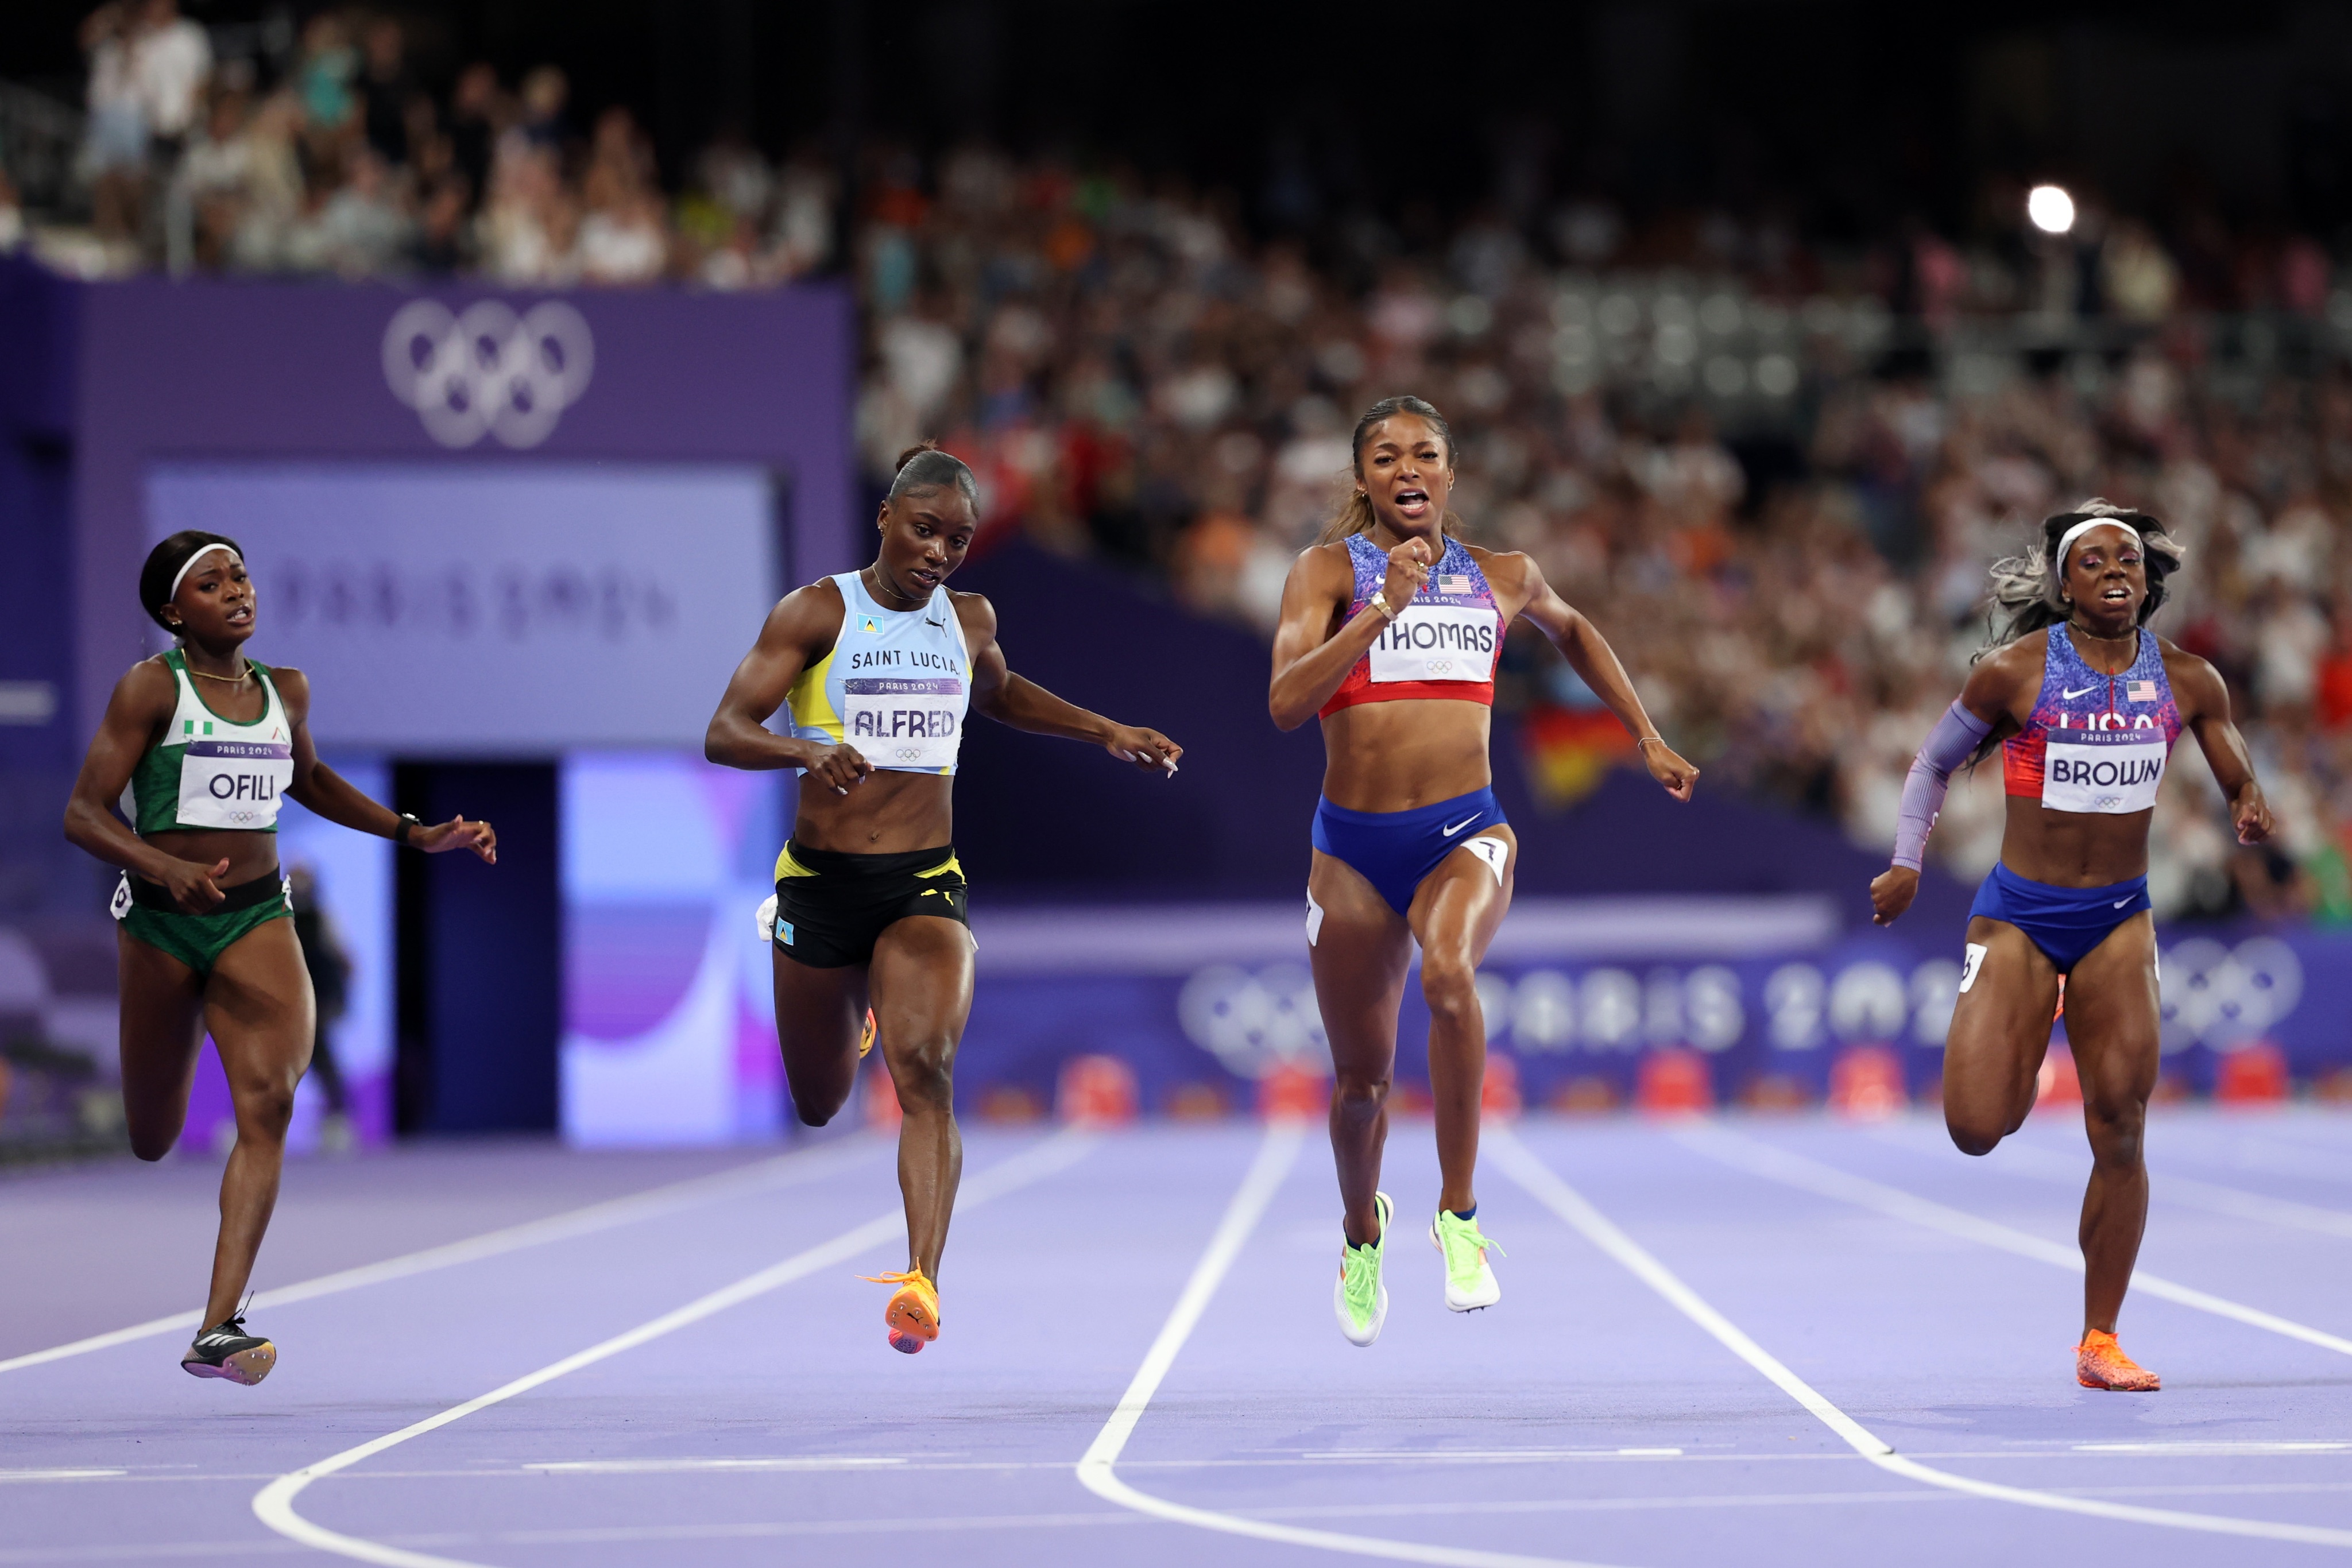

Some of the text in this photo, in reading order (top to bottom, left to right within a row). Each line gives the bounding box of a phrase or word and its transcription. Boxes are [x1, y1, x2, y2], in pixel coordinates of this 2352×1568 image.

[1434, 596, 1461, 605] 2024
[852, 650, 961, 676] SAINT LUCIA
[879, 682, 938, 691] PARIS 2024
[854, 710, 955, 738] ALFRED
[2081, 733, 2141, 742] PARIS 2024
[217, 745, 272, 756] PARIS 2024
[2053, 757, 2161, 787] BROWN
[209, 773, 274, 801] OFILI
